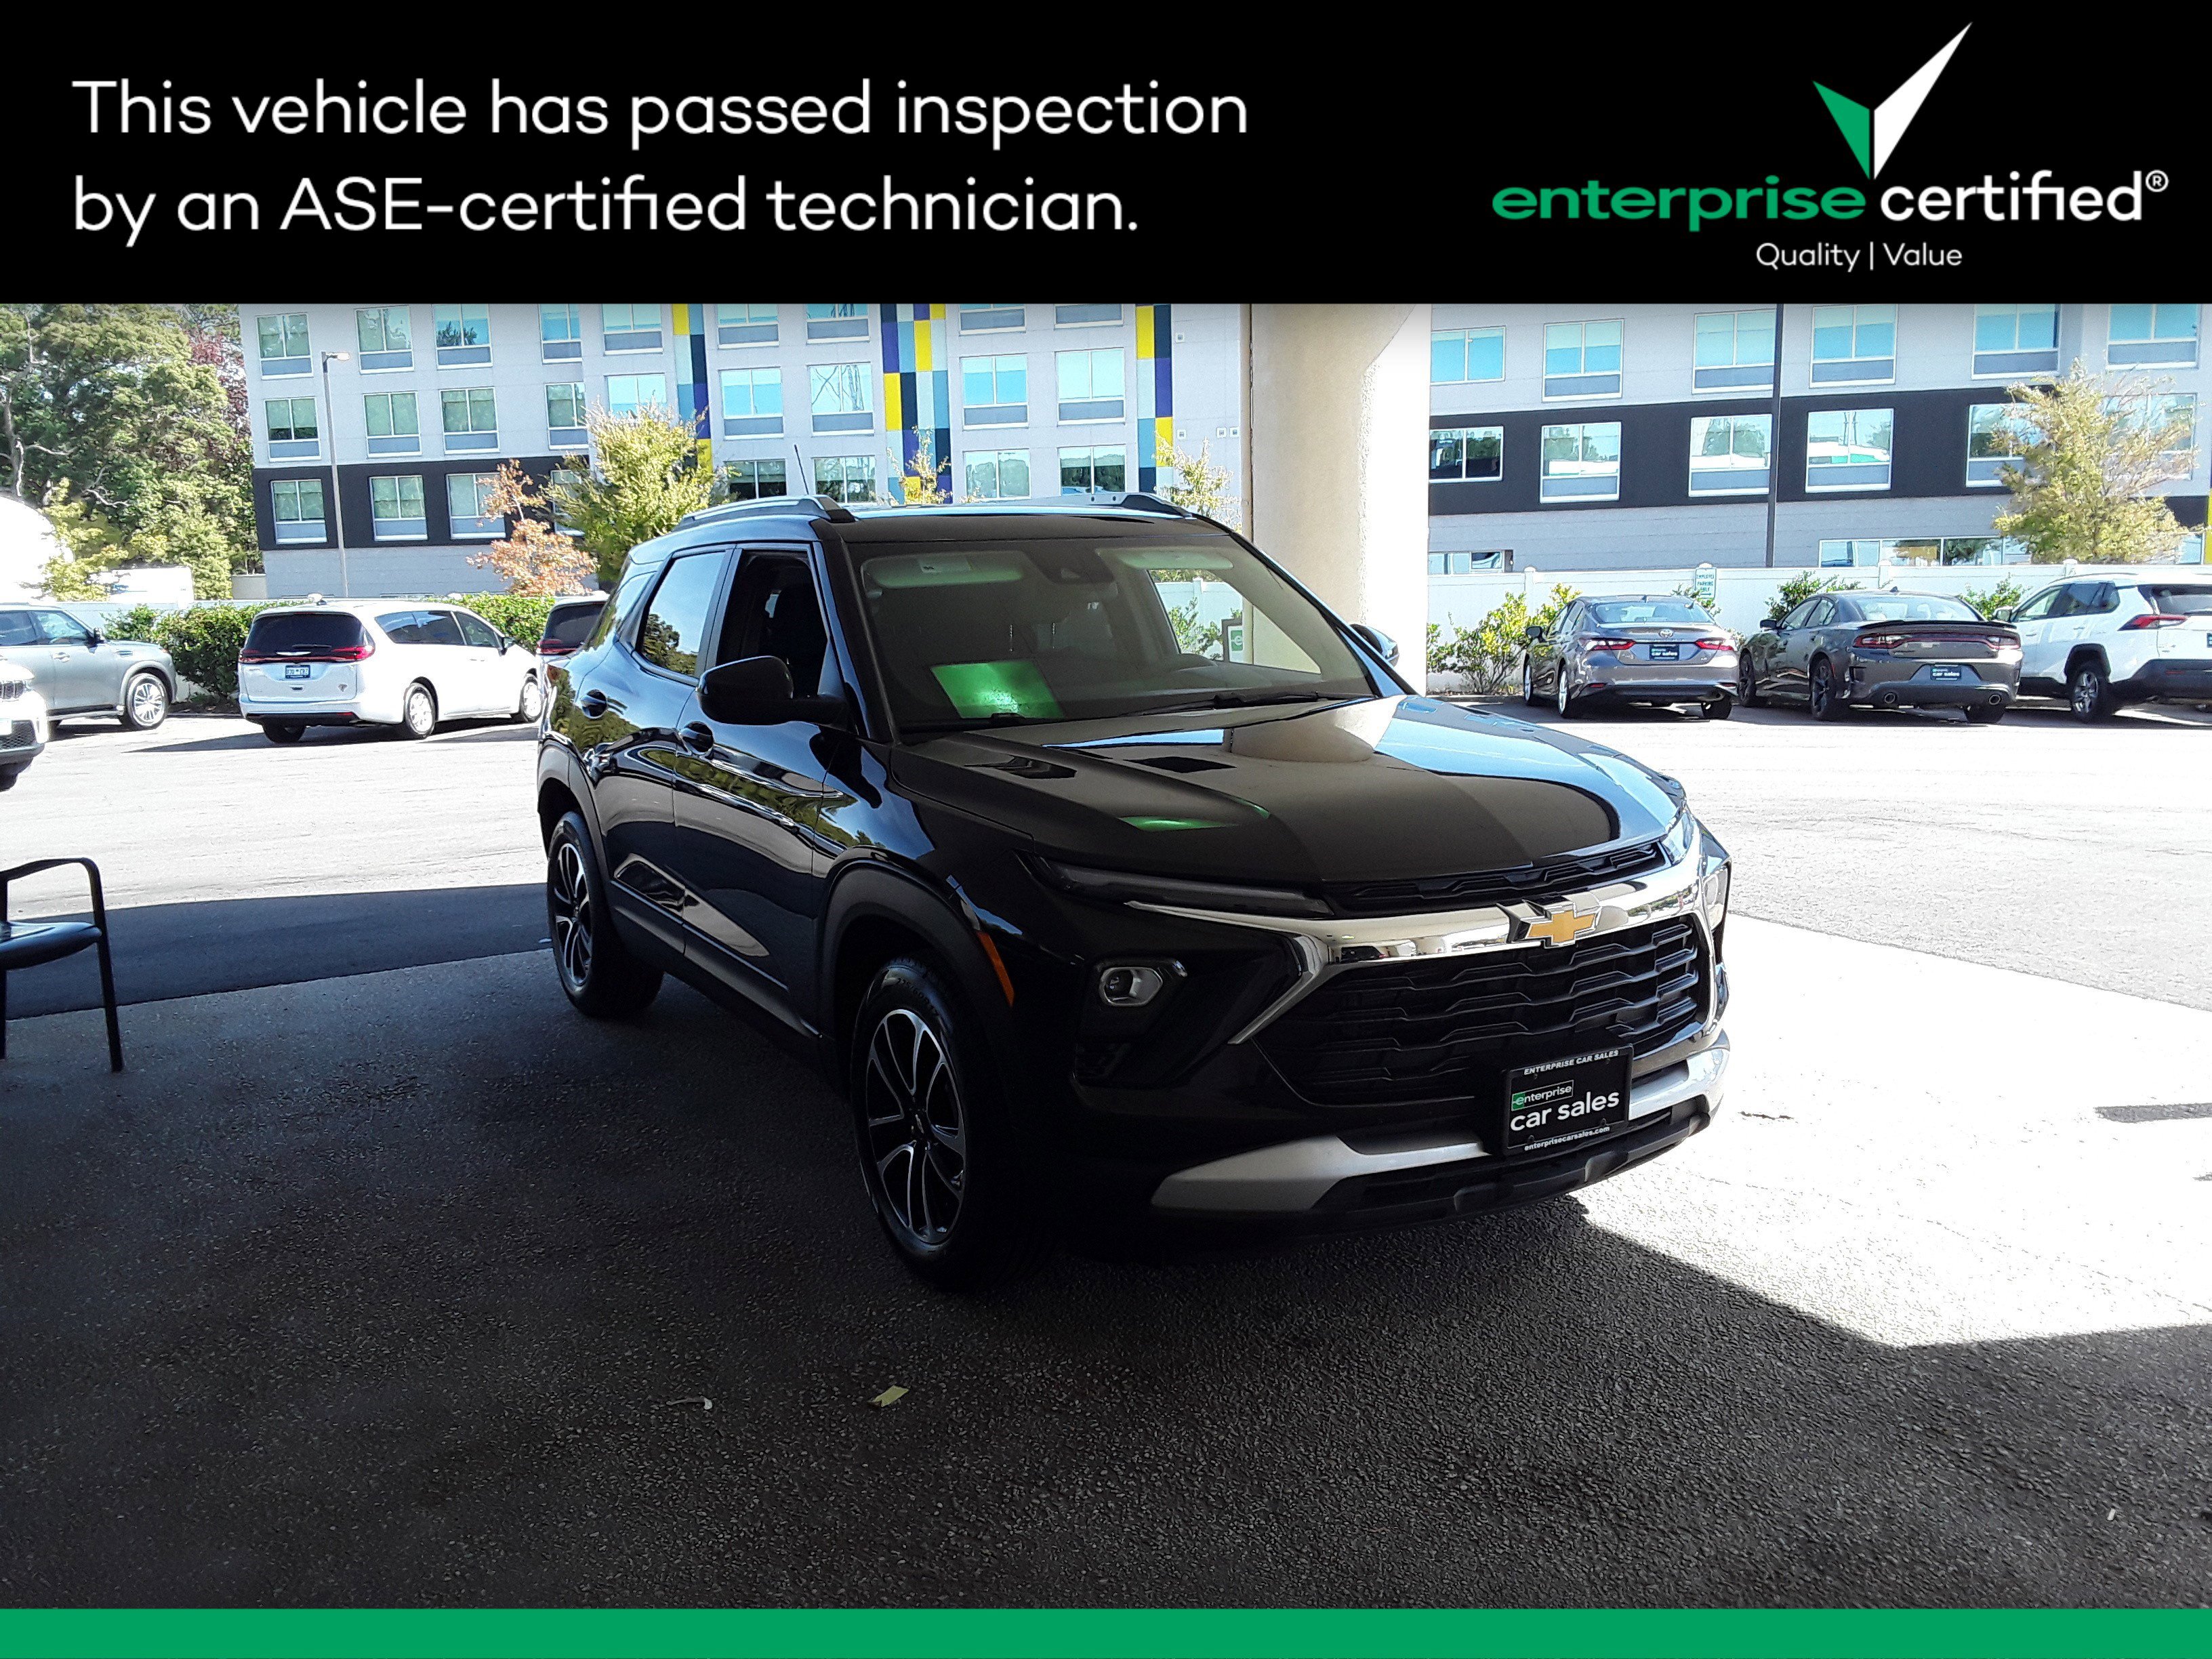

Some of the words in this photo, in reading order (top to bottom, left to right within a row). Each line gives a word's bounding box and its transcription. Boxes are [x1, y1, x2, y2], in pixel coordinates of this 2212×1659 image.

[1524, 1059, 1574, 1076] ENTERPRISE
[1576, 1055, 1593, 1065] CAR
[1594, 1050, 1619, 1061] SALES
[1515, 1086, 1572, 1105] enterprise
[1511, 1108, 1552, 1131] car
[1557, 1091, 1620, 1120] sales
[1524, 1126, 1610, 1151] enterprisecarsales.com
